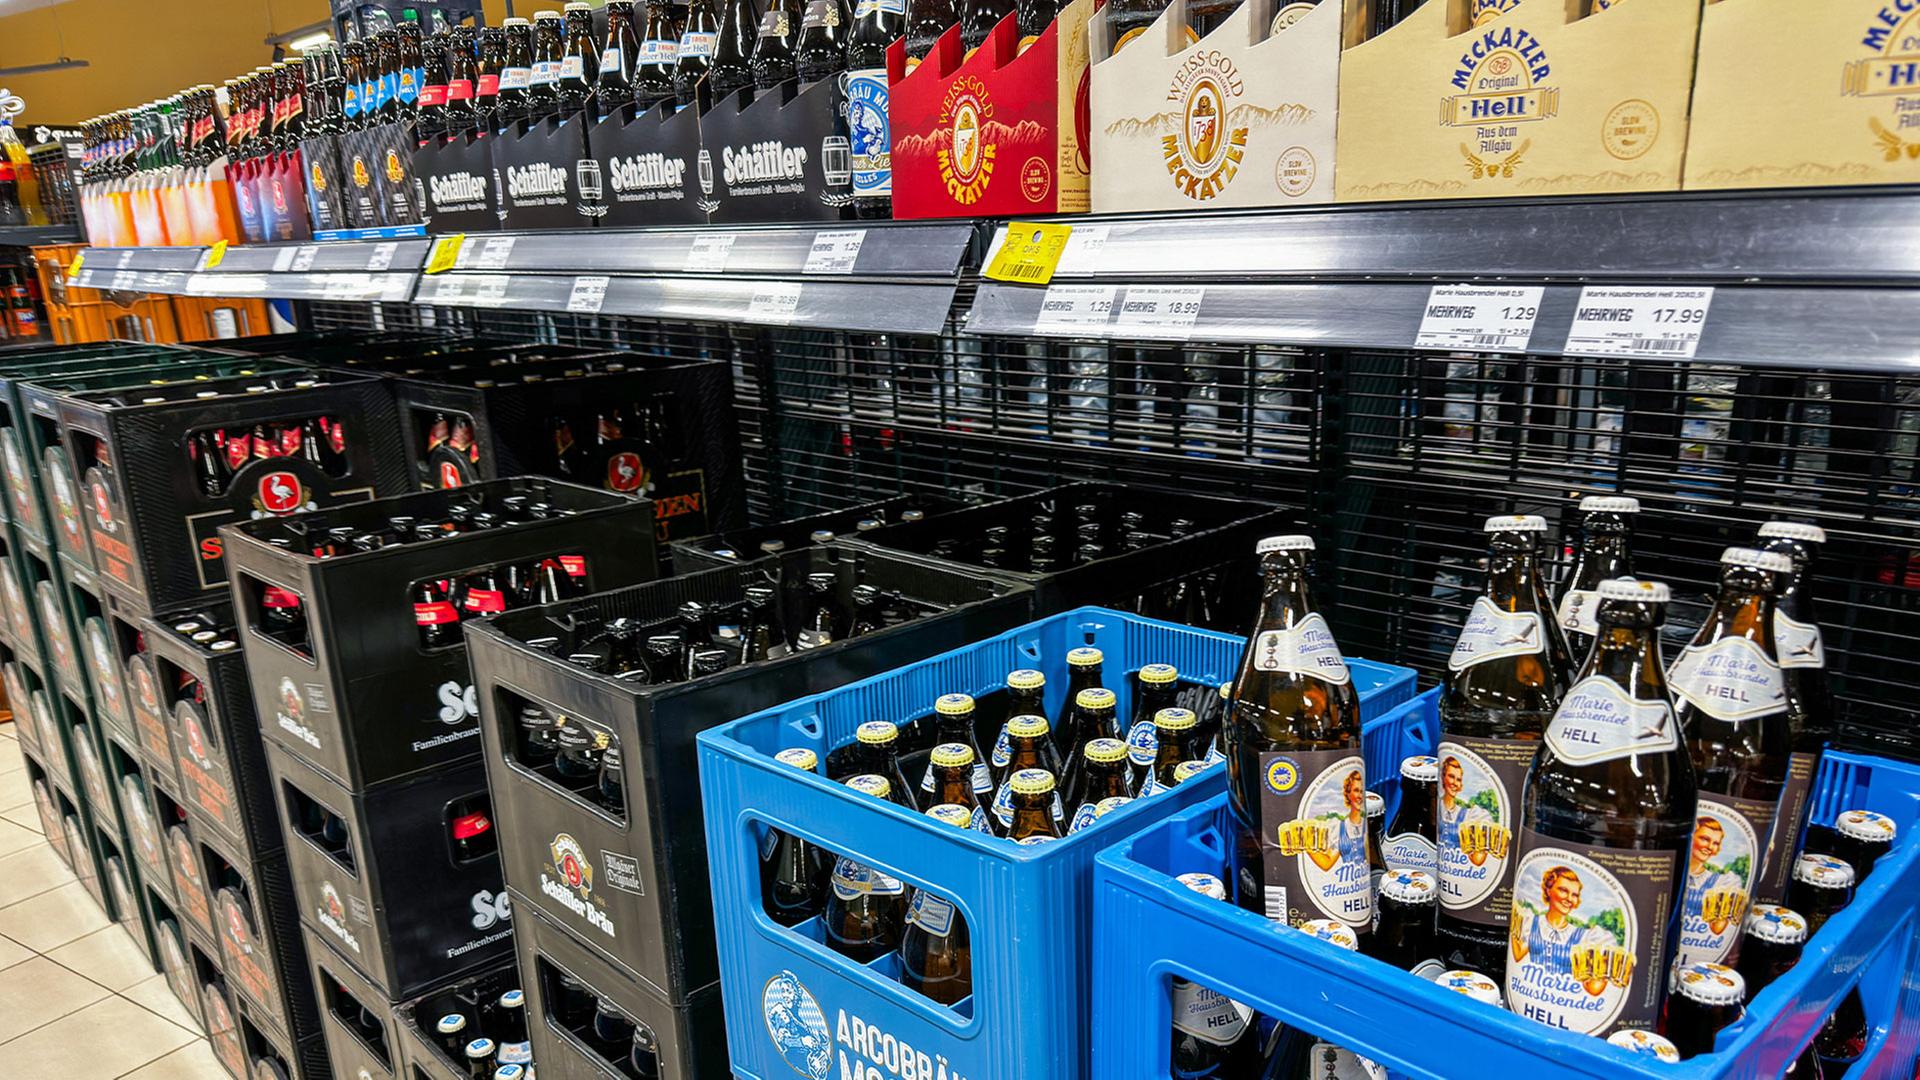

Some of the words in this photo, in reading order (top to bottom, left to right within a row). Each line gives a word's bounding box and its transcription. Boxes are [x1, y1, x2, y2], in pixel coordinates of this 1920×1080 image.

[1862, 0, 1920, 51] MEC
[1451, 27, 1550, 89] MECKATZER
[1167, 50, 1244, 102] WEISS-GOLD
[1478, 75, 1518, 90] Original
[1889, 63, 1920, 86] H
[939, 75, 993, 123] WEISS-GOLD
[1471, 96, 1526, 118] Hell
[1476, 127, 1496, 140] Aus
[1497, 126, 1518, 137] dem
[1480, 140, 1512, 154] Allgäu
[610, 152, 686, 193] Schäffler
[723, 140, 808, 187] Schäffler
[1162, 127, 1249, 201] MECKATZER
[507, 162, 569, 199] Schäffler
[937, 143, 997, 205] MECKATZER
[430, 171, 488, 206] Schäffler
[1042, 301, 1074, 312] MEHRWEG
[1089, 301, 1112, 312] 1.29
[1122, 301, 1158, 313] MEHRWEG
[1168, 302, 1200, 314] 18.99
[1426, 305, 1476, 319] MEHRWEG
[1502, 306, 1537, 320] 1.29
[1576, 308, 1634, 322] MEHRWEG
[1652, 308, 1705, 323] 17.99
[1316, 656, 1343, 668] HELL
[1707, 654, 1758, 673] Marie
[1570, 695, 1614, 712] Marie
[1705, 684, 1750, 703] HELL
[1558, 709, 1630, 726] Hausbrendel
[1562, 727, 1601, 745] HELL
[1393, 845, 1428, 859] Marie
[541, 874, 585, 918] Schäffler
[585, 901, 616, 938] Bräu
[1343, 897, 1370, 913] HELL
[1521, 964, 1582, 994] Marie
[1511, 976, 1606, 1012] Hausbrendel
[1207, 1011, 1240, 1028] HELL
[1523, 1003, 1570, 1031] HELL
